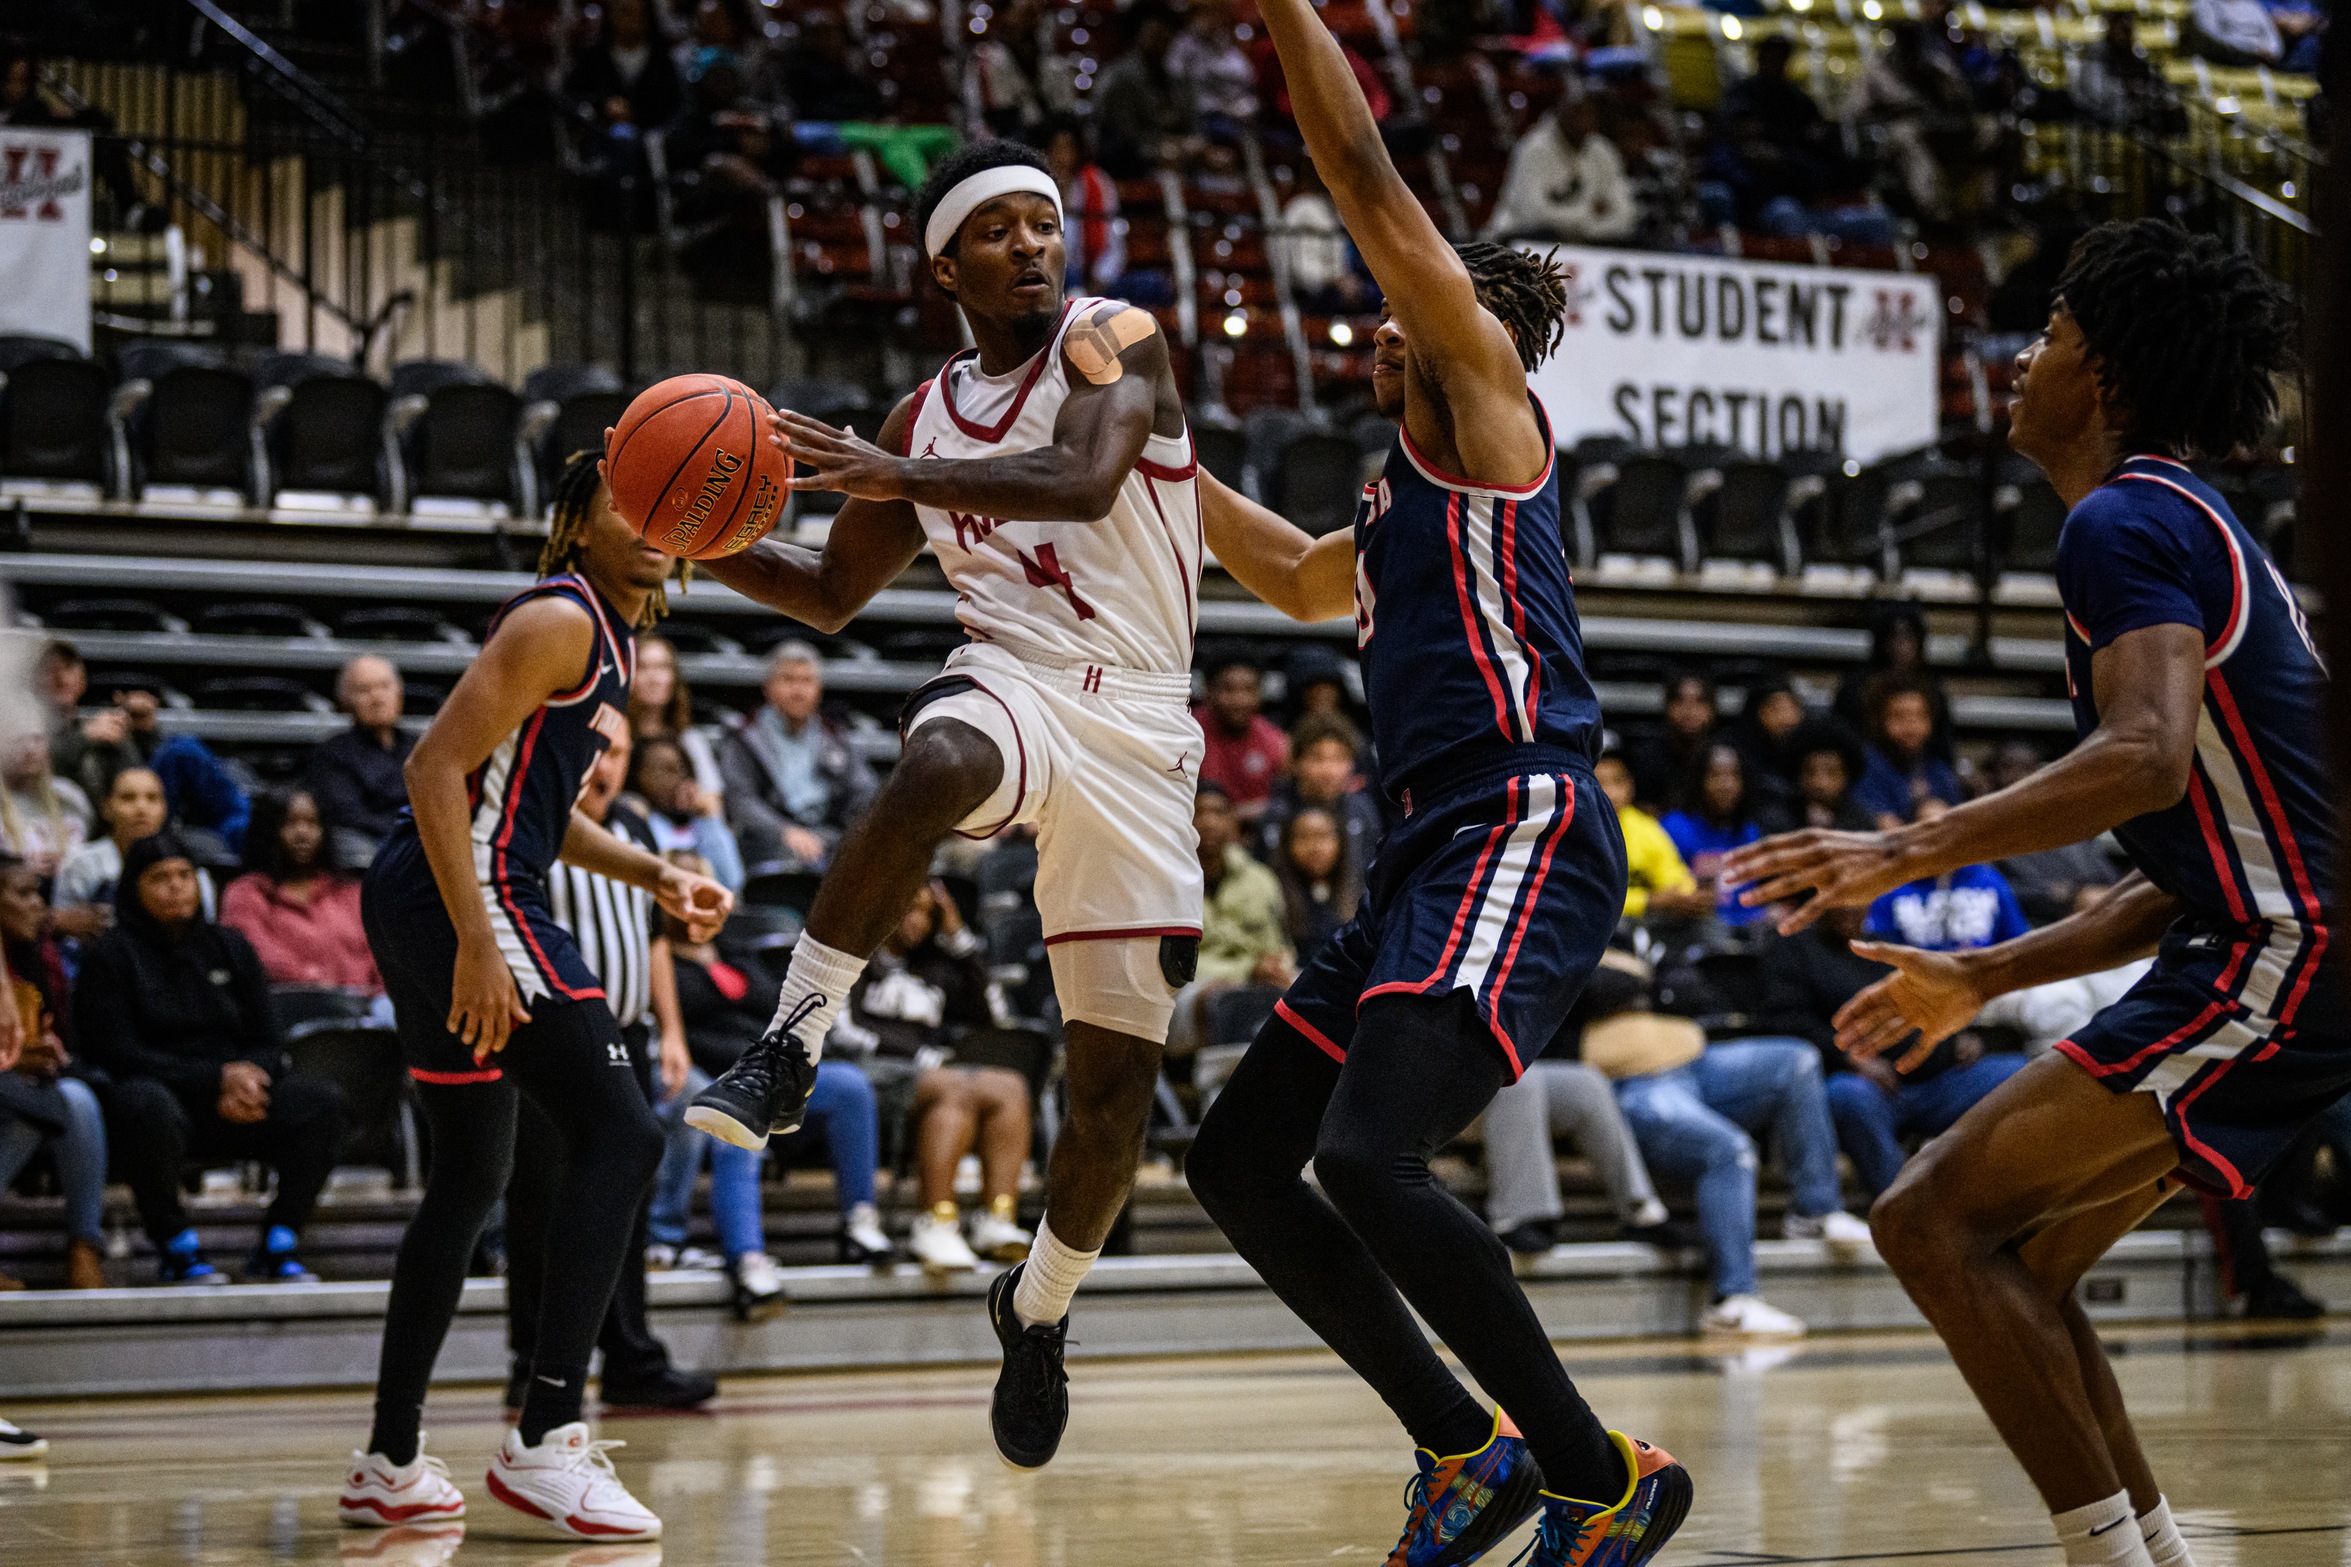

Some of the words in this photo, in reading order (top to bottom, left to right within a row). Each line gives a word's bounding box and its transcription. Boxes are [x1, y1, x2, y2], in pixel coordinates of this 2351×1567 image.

[1604, 264, 1855, 350] STUDENT
[1613, 383, 1845, 463] SECTION
[661, 448, 743, 552] SPALDING
[722, 474, 772, 549] EGACY
[1083, 665, 1103, 693] H
